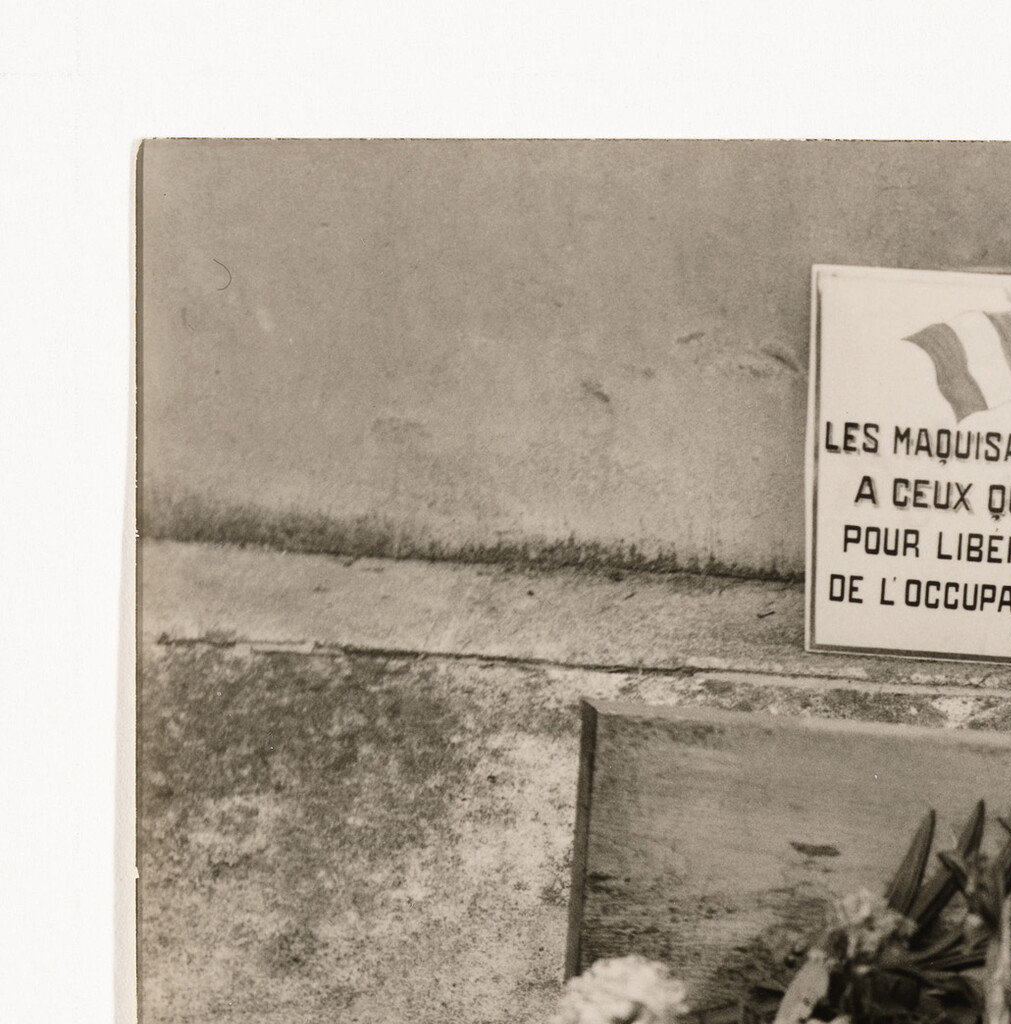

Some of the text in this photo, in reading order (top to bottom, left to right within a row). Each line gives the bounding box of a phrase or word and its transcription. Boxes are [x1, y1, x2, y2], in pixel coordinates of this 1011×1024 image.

[825, 421, 880, 454] LES
[854, 475, 878, 506] A
[892, 477, 973, 512] CEUX
[843, 524, 920, 558] POUR
[829, 573, 863, 604] DE
